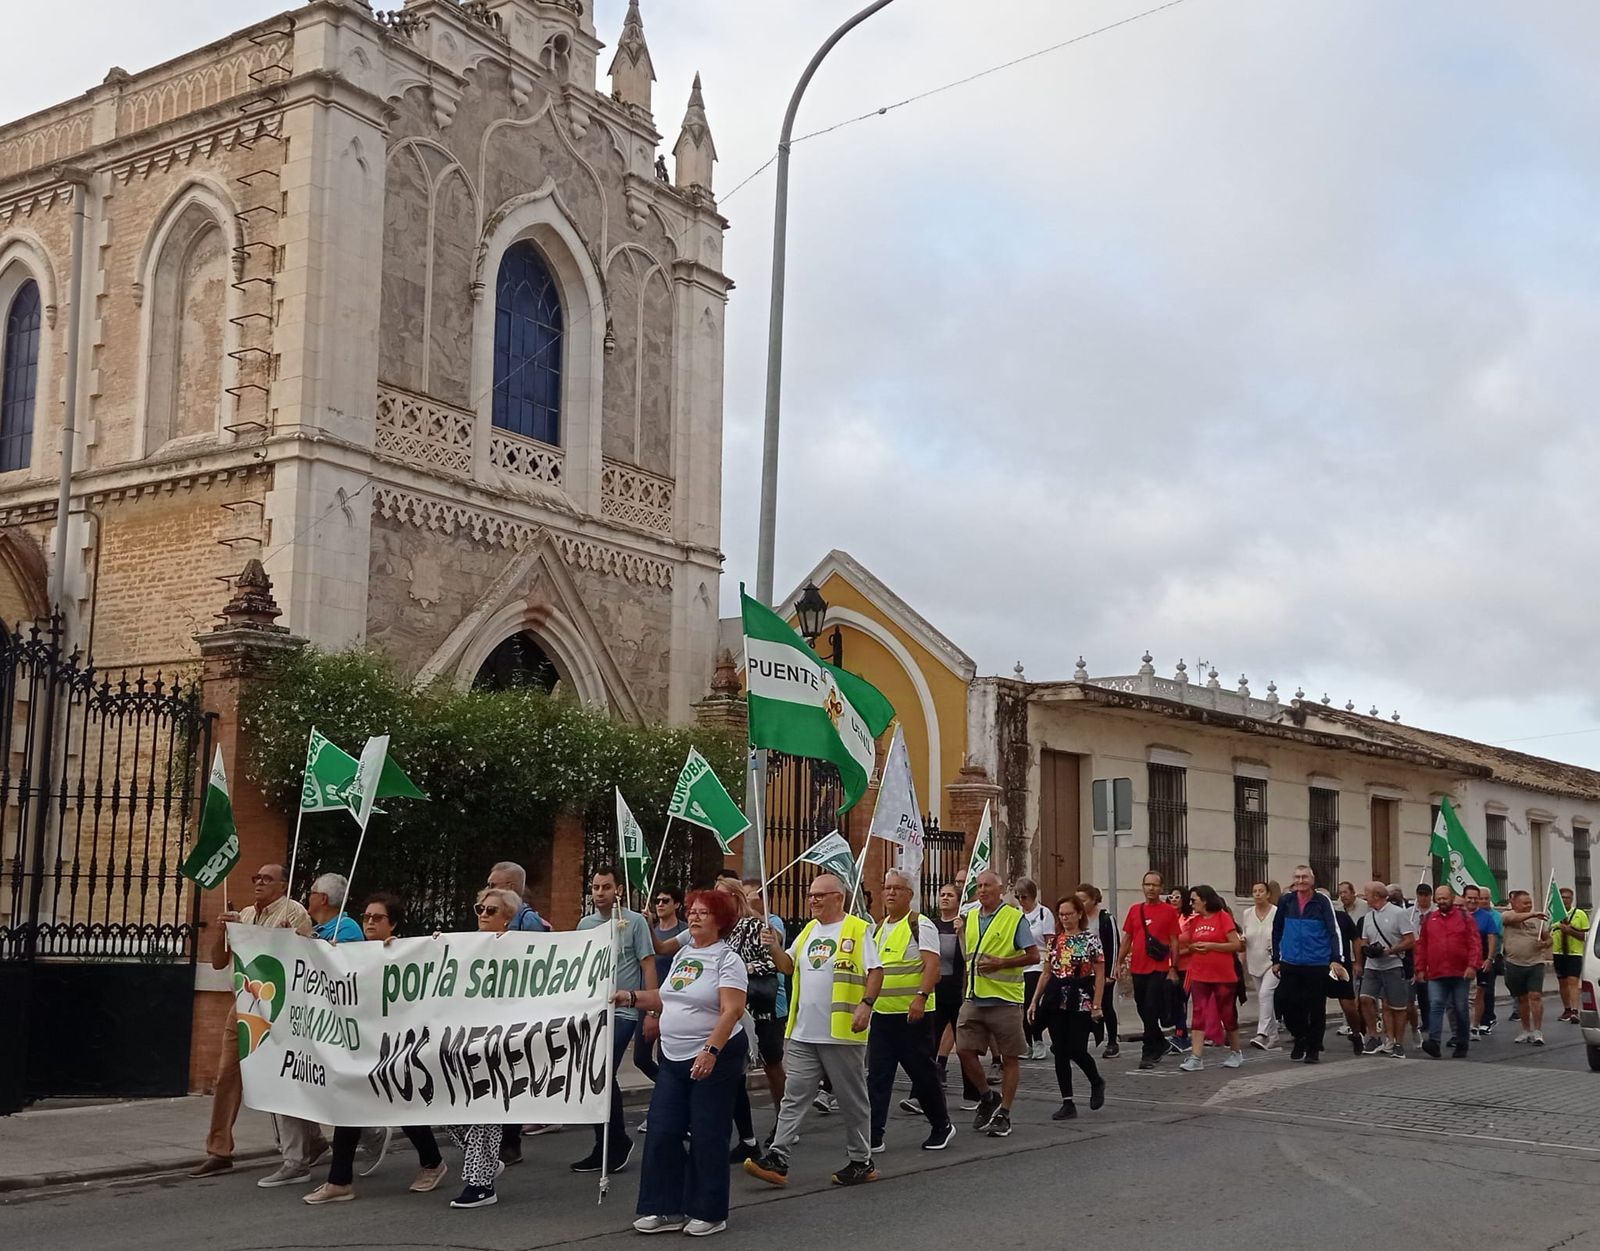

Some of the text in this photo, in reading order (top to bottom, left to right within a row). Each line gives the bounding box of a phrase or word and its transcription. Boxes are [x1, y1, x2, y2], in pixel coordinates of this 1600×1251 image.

[749, 658, 818, 691] PUENTE
[382, 961, 435, 1017] por
[432, 945, 458, 997] la
[464, 940, 592, 999] sanidad
[280, 1050, 326, 1087] Pública
[367, 1025, 434, 1107] NOS
